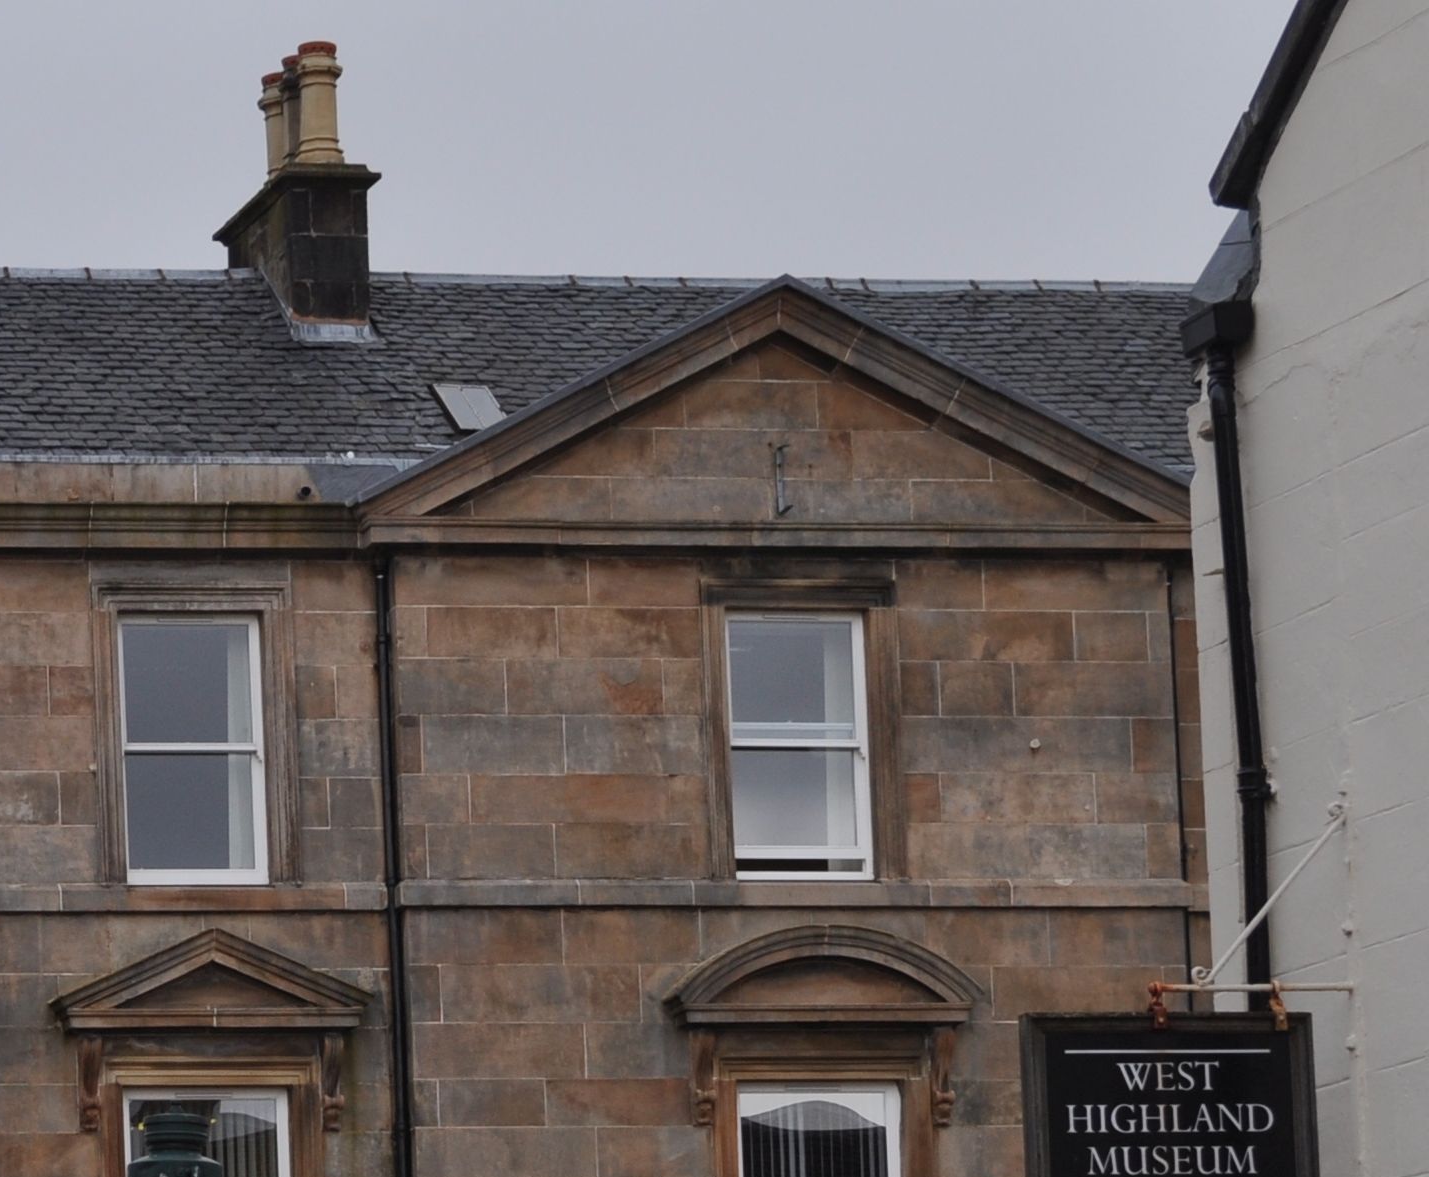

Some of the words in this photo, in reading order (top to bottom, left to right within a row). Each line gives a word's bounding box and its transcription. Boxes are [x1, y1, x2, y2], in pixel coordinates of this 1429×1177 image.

[1116, 1061, 1220, 1091] WEST
[1066, 1102, 1274, 1134] HIGHLAND
[1087, 1145, 1258, 1176] MUSEUM
